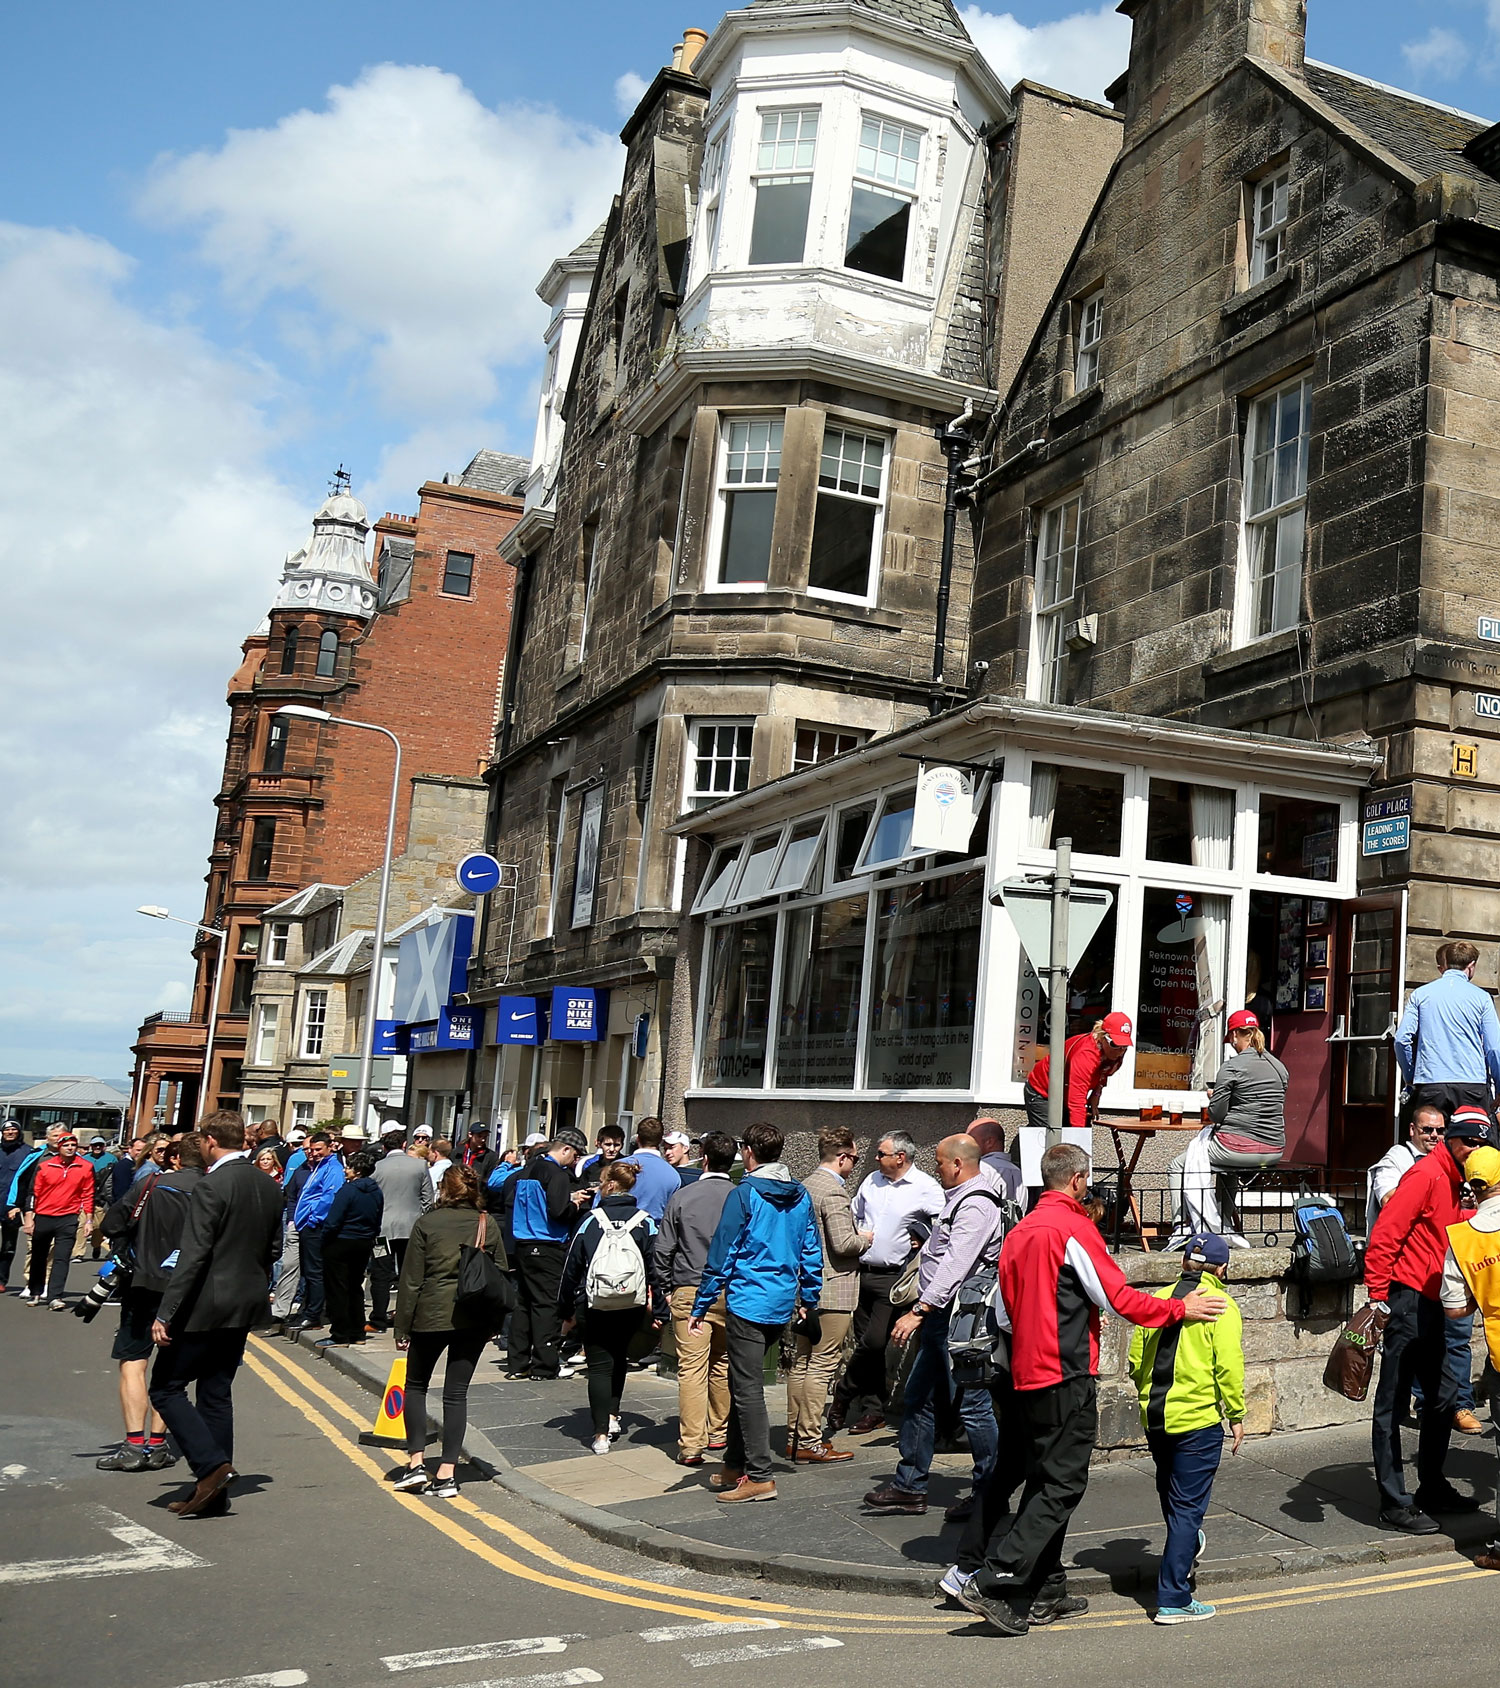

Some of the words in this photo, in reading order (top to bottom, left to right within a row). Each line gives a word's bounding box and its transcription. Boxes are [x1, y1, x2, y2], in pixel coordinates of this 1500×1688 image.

[1456, 747, 1474, 774] H
[1386, 798, 1408, 814] PLACE
[1367, 823, 1393, 836] LEADING
[1396, 821, 1405, 831] TO
[1367, 840, 1379, 850] THE
[1382, 835, 1405, 847] SCORES
[1149, 951, 1189, 962] Reknown
[1150, 965, 1167, 976] Jug
[1169, 966, 1198, 977] Restau
[1153, 978, 1179, 989] Open
[568, 1000, 593, 1009] ONE
[1140, 1004, 1172, 1016] Quality
[567, 1009, 592, 1018] NIKE
[566, 1019, 592, 1028] PLACE
[1166, 1019, 1195, 1029] Steaks
[958, 1031, 969, 1044] the
[936, 1072, 953, 1086] 2005
